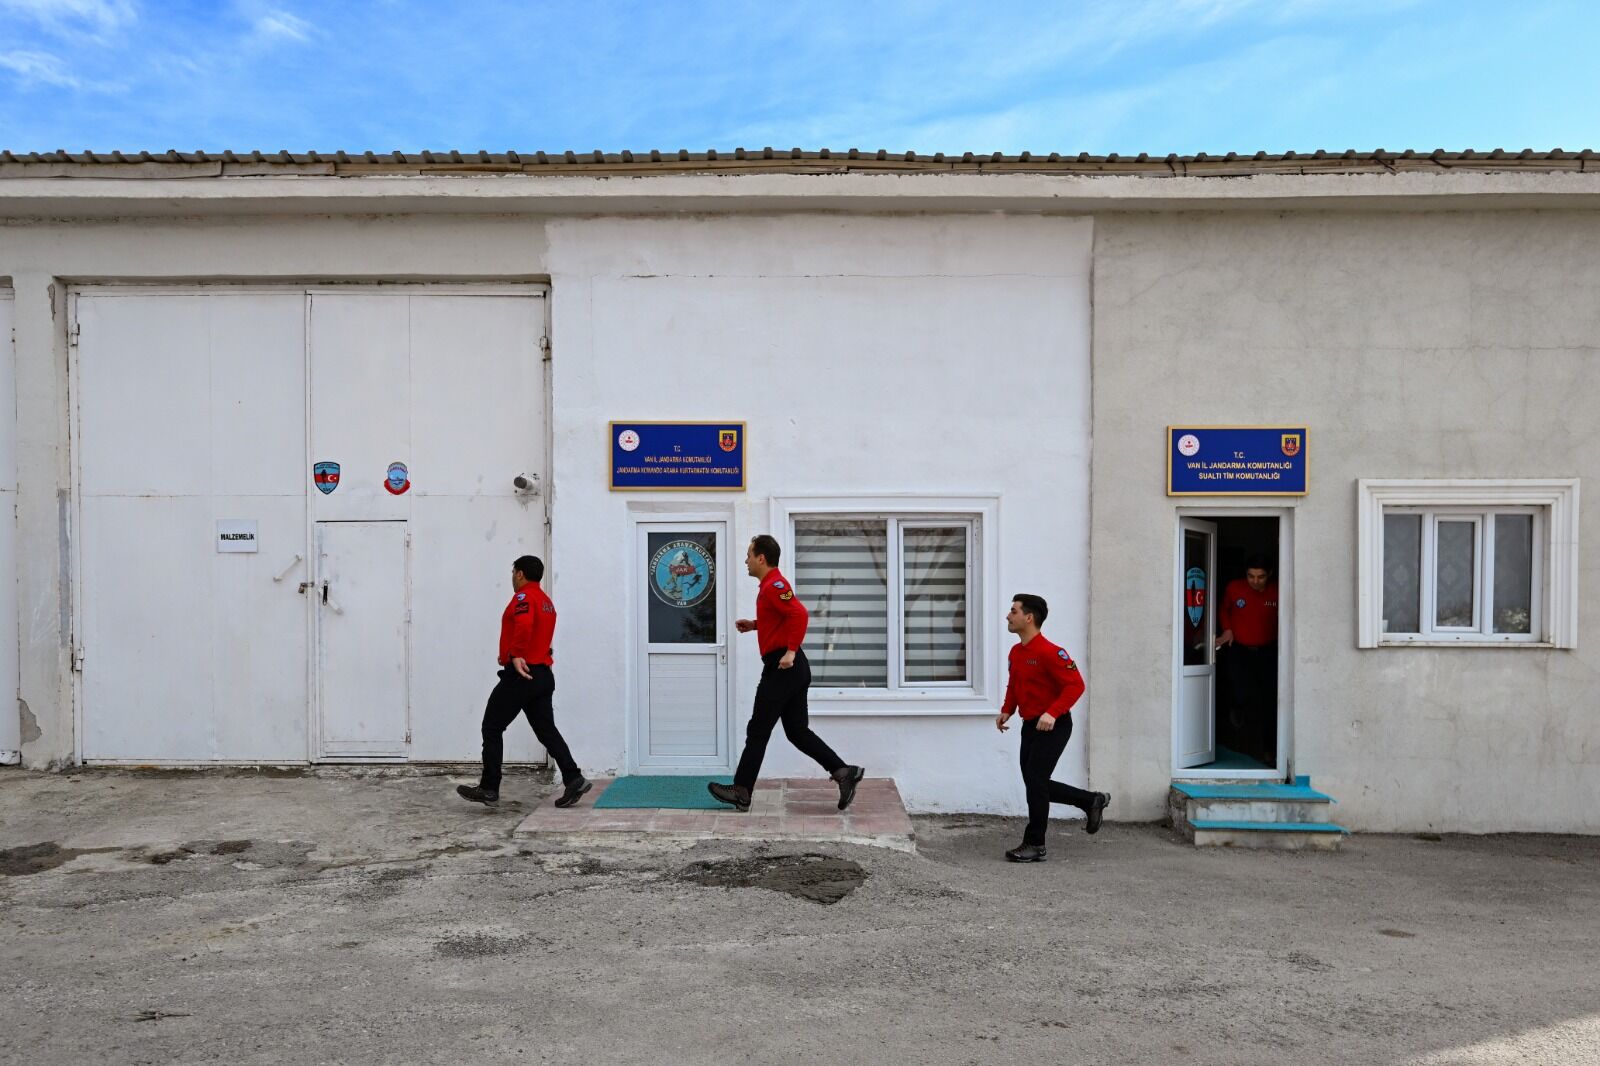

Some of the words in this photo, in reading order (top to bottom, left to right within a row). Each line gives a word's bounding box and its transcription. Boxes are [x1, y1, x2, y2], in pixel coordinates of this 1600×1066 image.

[1233, 451, 1245, 459] T.C.
[1201, 461, 1208, 469] İL
[1247, 461, 1292, 469] KOMUTANLIĞI
[1199, 472, 1221, 480] SUALTI
[1222, 471, 1234, 480] TİM
[1235, 471, 1280, 480] KOMUTANLIĞI
